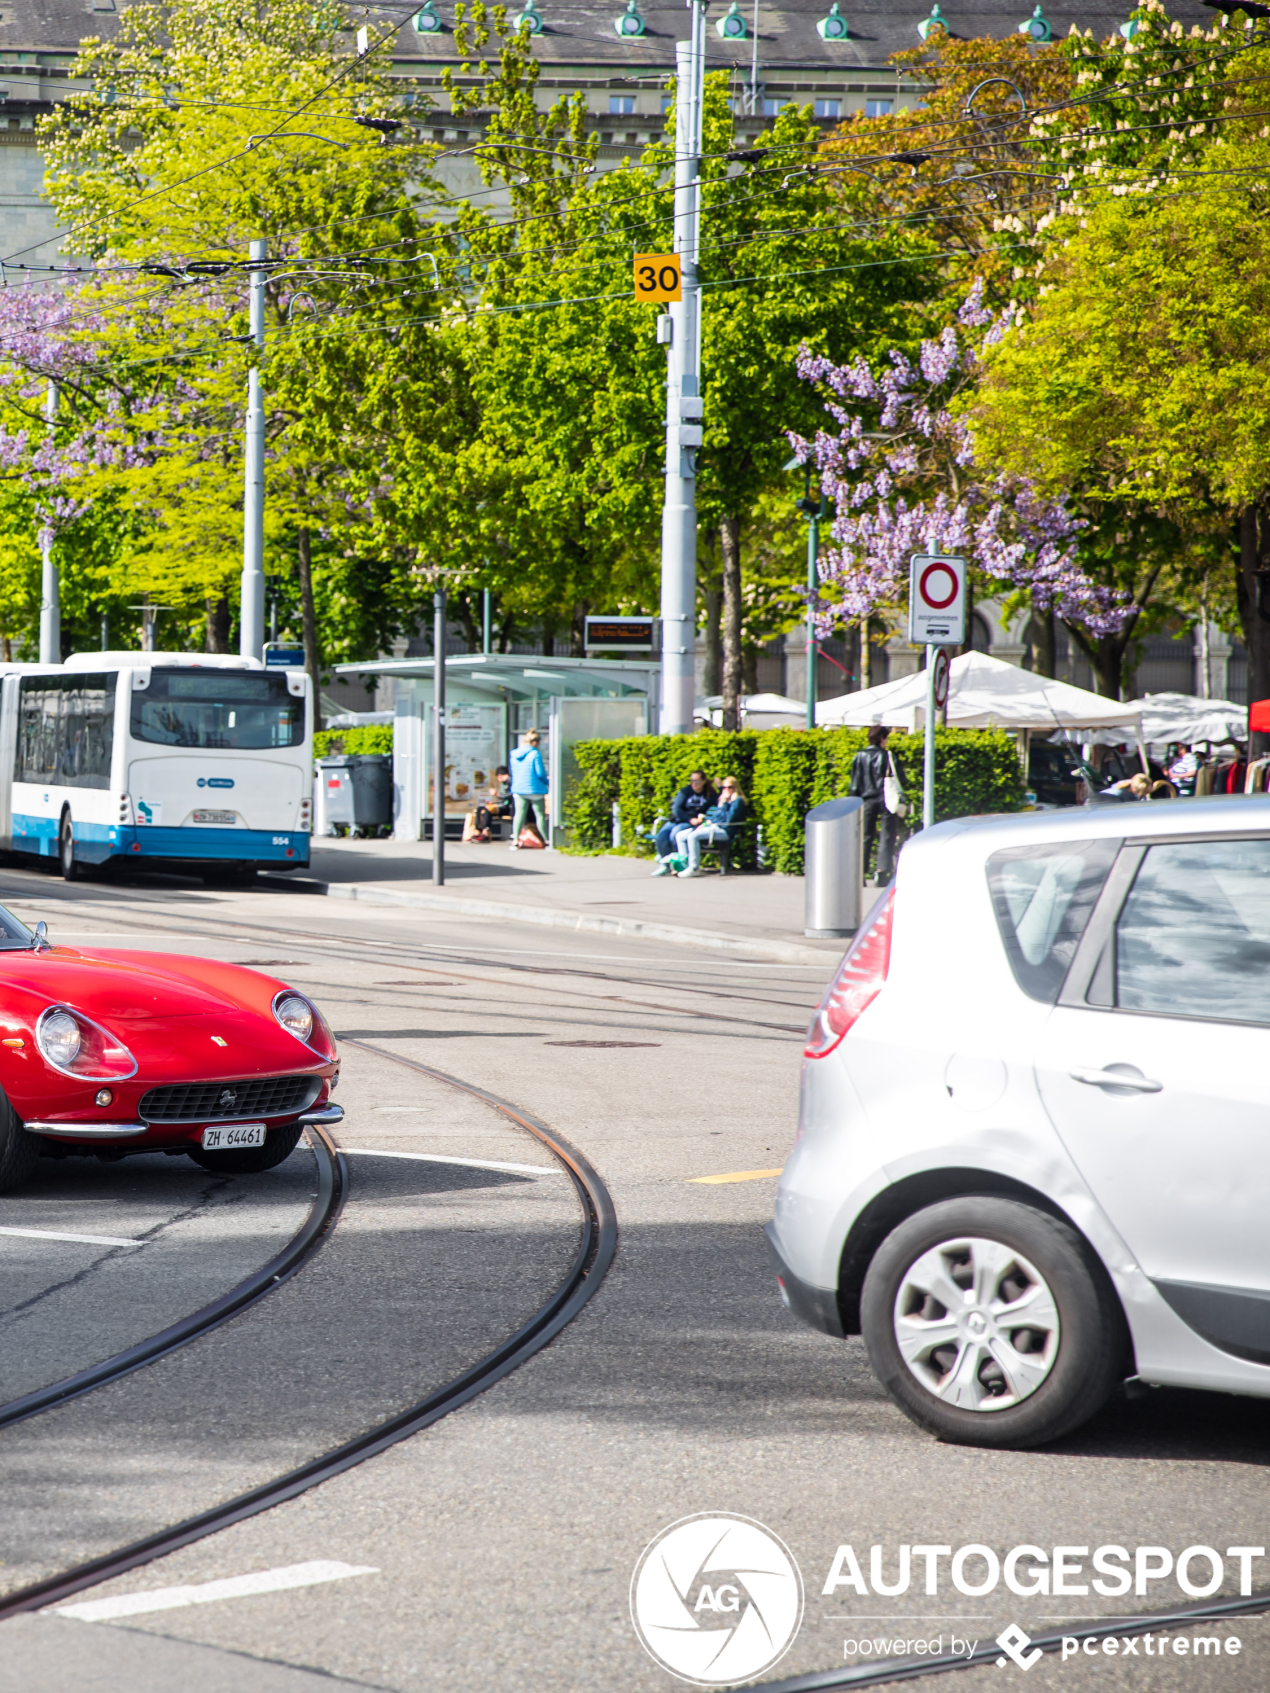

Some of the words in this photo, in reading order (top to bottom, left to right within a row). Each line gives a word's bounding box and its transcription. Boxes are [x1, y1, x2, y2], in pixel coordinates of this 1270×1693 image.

[638, 265, 679, 292] 30
[272, 837, 289, 845] 554
[206, 1131, 221, 1147] ZH
[227, 1129, 260, 1144] 64461
